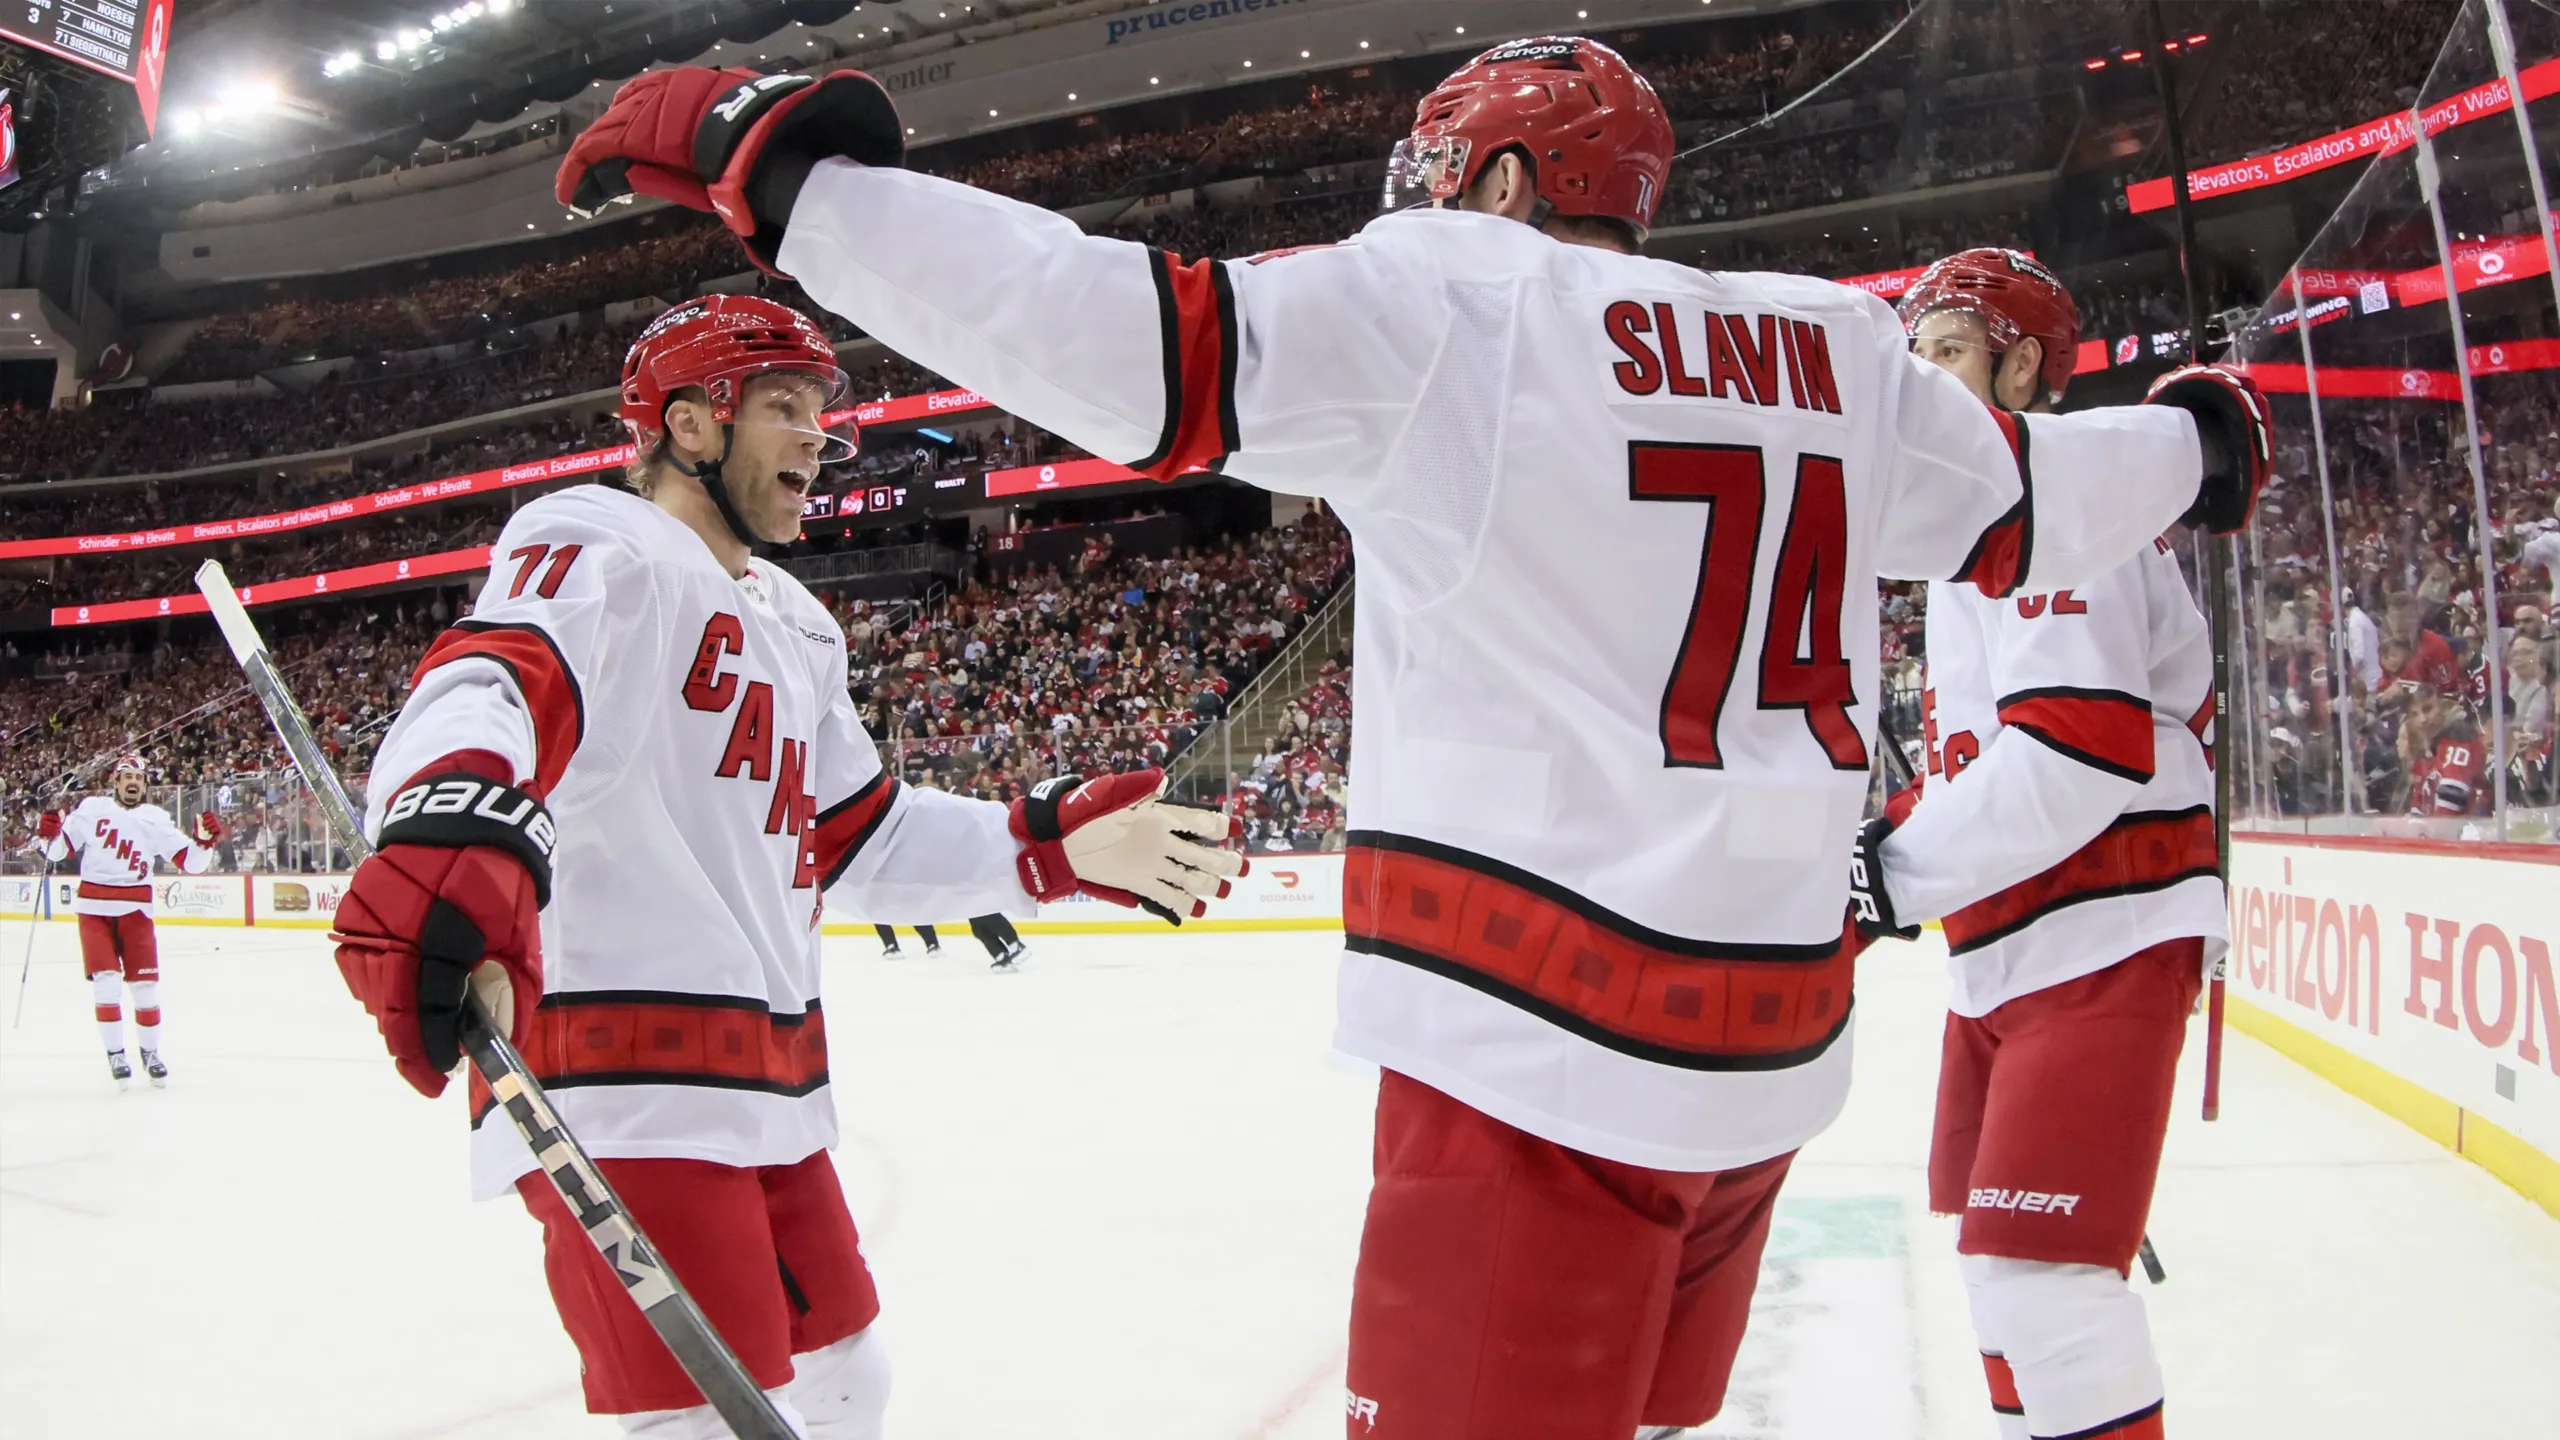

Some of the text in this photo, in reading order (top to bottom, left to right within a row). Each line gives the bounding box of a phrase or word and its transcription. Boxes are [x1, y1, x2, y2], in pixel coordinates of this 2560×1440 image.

[28, 7, 40, 24] 3
[62, 10, 132, 46] 7 HAMILTON
[97, 3, 135, 27] NOESEN
[55, 30, 128, 67] 71 SIEGENTHALER
[1491, 45, 1568, 60] Lenovo
[2274, 135, 2355, 175] Escalators
[2359, 122, 2391, 148] and
[643, 307, 700, 336] Lenovo
[1603, 300, 1843, 415] SLAVIN
[502, 466, 547, 483] Elevators,
[551, 455, 600, 473] Escalators
[602, 448, 622, 463] and
[375, 490, 412, 508] Schindler
[422, 485, 437, 498] We
[440, 478, 471, 494] Elevate
[875, 492, 884, 506] 0
[934, 477, 966, 490] PENALTY
[895, 496, 903, 506] 3
[194, 503, 353, 537] Elevators, Escalators and Moving Walks
[79, 537, 120, 549] Schindler
[130, 535, 144, 546] We
[145, 531, 175, 544] Elevate
[998, 538, 1013, 550] 18
[508, 543, 583, 600] 71
[1627, 440, 1870, 771] 74
[681, 611, 822, 932] CANE
[383, 781, 556, 868] BAUE
[95, 818, 148, 881] CANES
[2228, 856, 2380, 1037] verizon
[492, 1071, 679, 1311] CCM
[1967, 1188, 2081, 1215] BAUER
